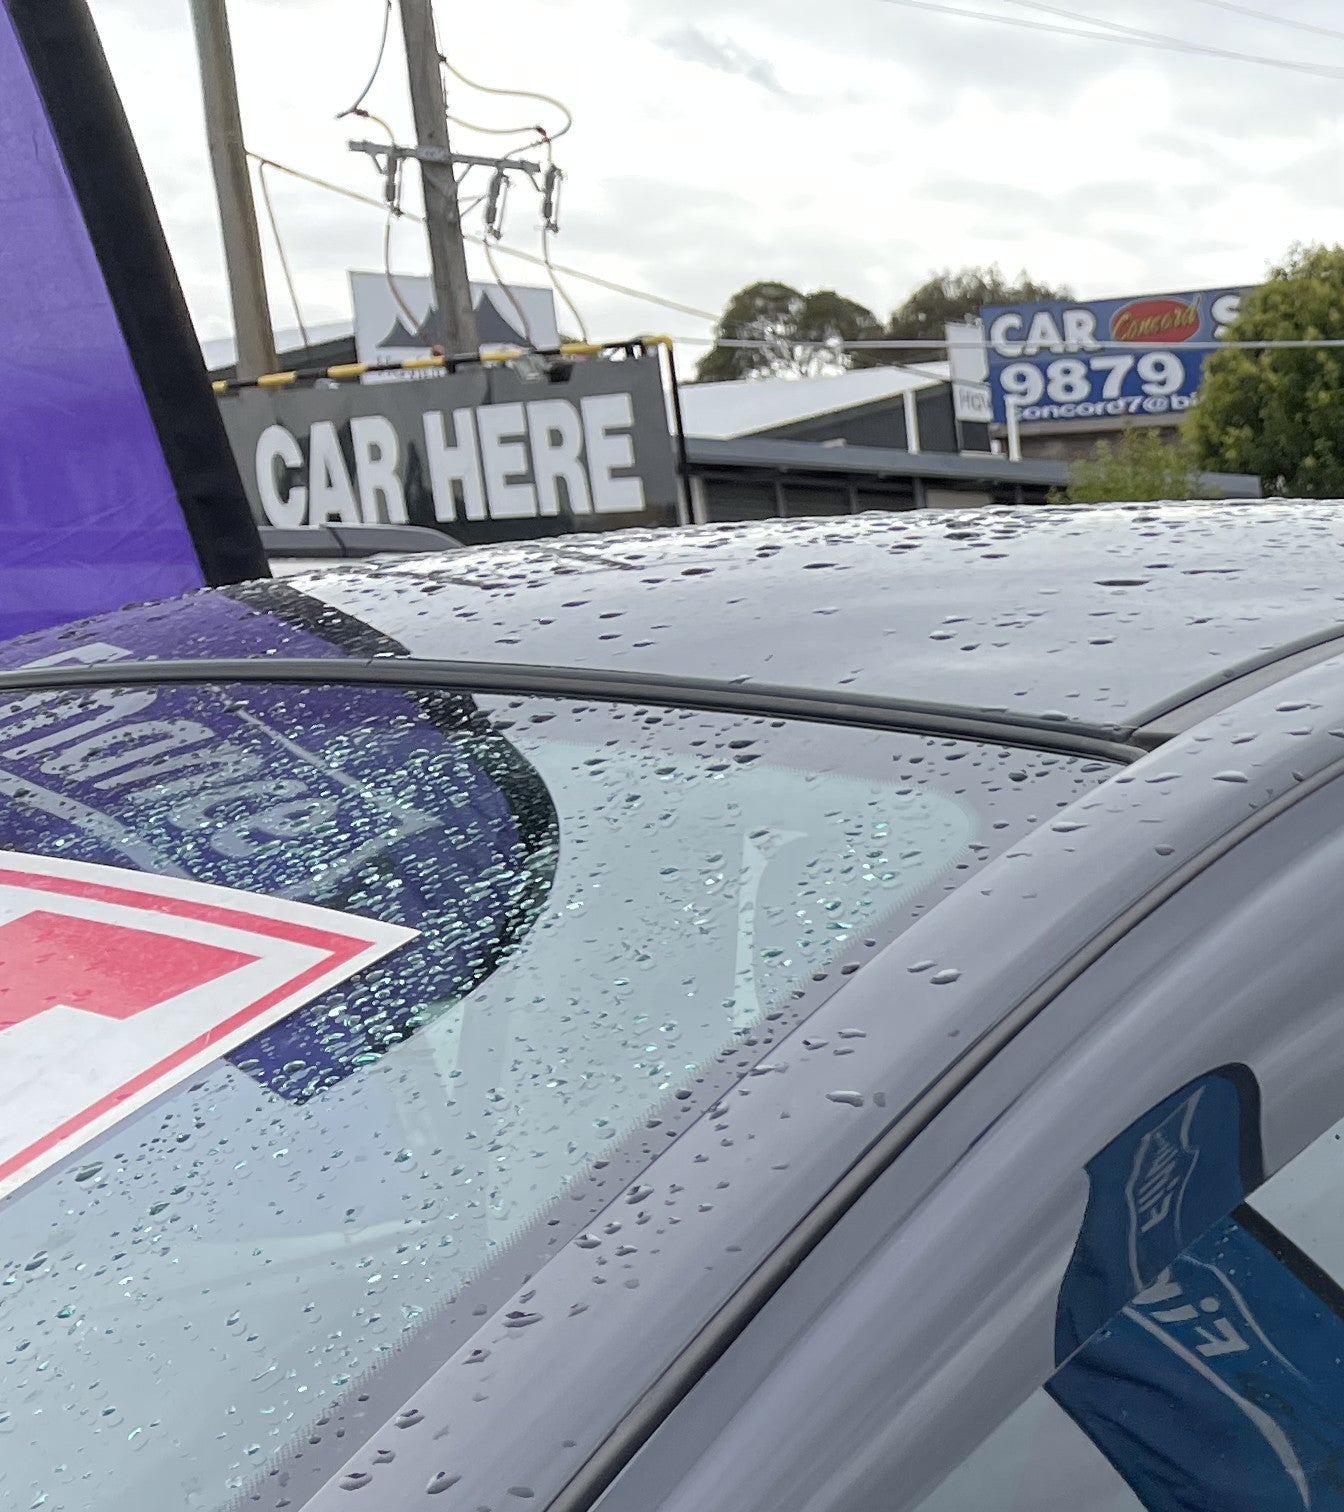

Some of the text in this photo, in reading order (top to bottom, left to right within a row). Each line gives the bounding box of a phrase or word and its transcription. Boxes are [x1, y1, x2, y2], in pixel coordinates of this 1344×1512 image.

[990, 308, 1099, 358] CAR
[1000, 351, 1185, 406] 9879
[255, 392, 646, 529] CAR HERE
